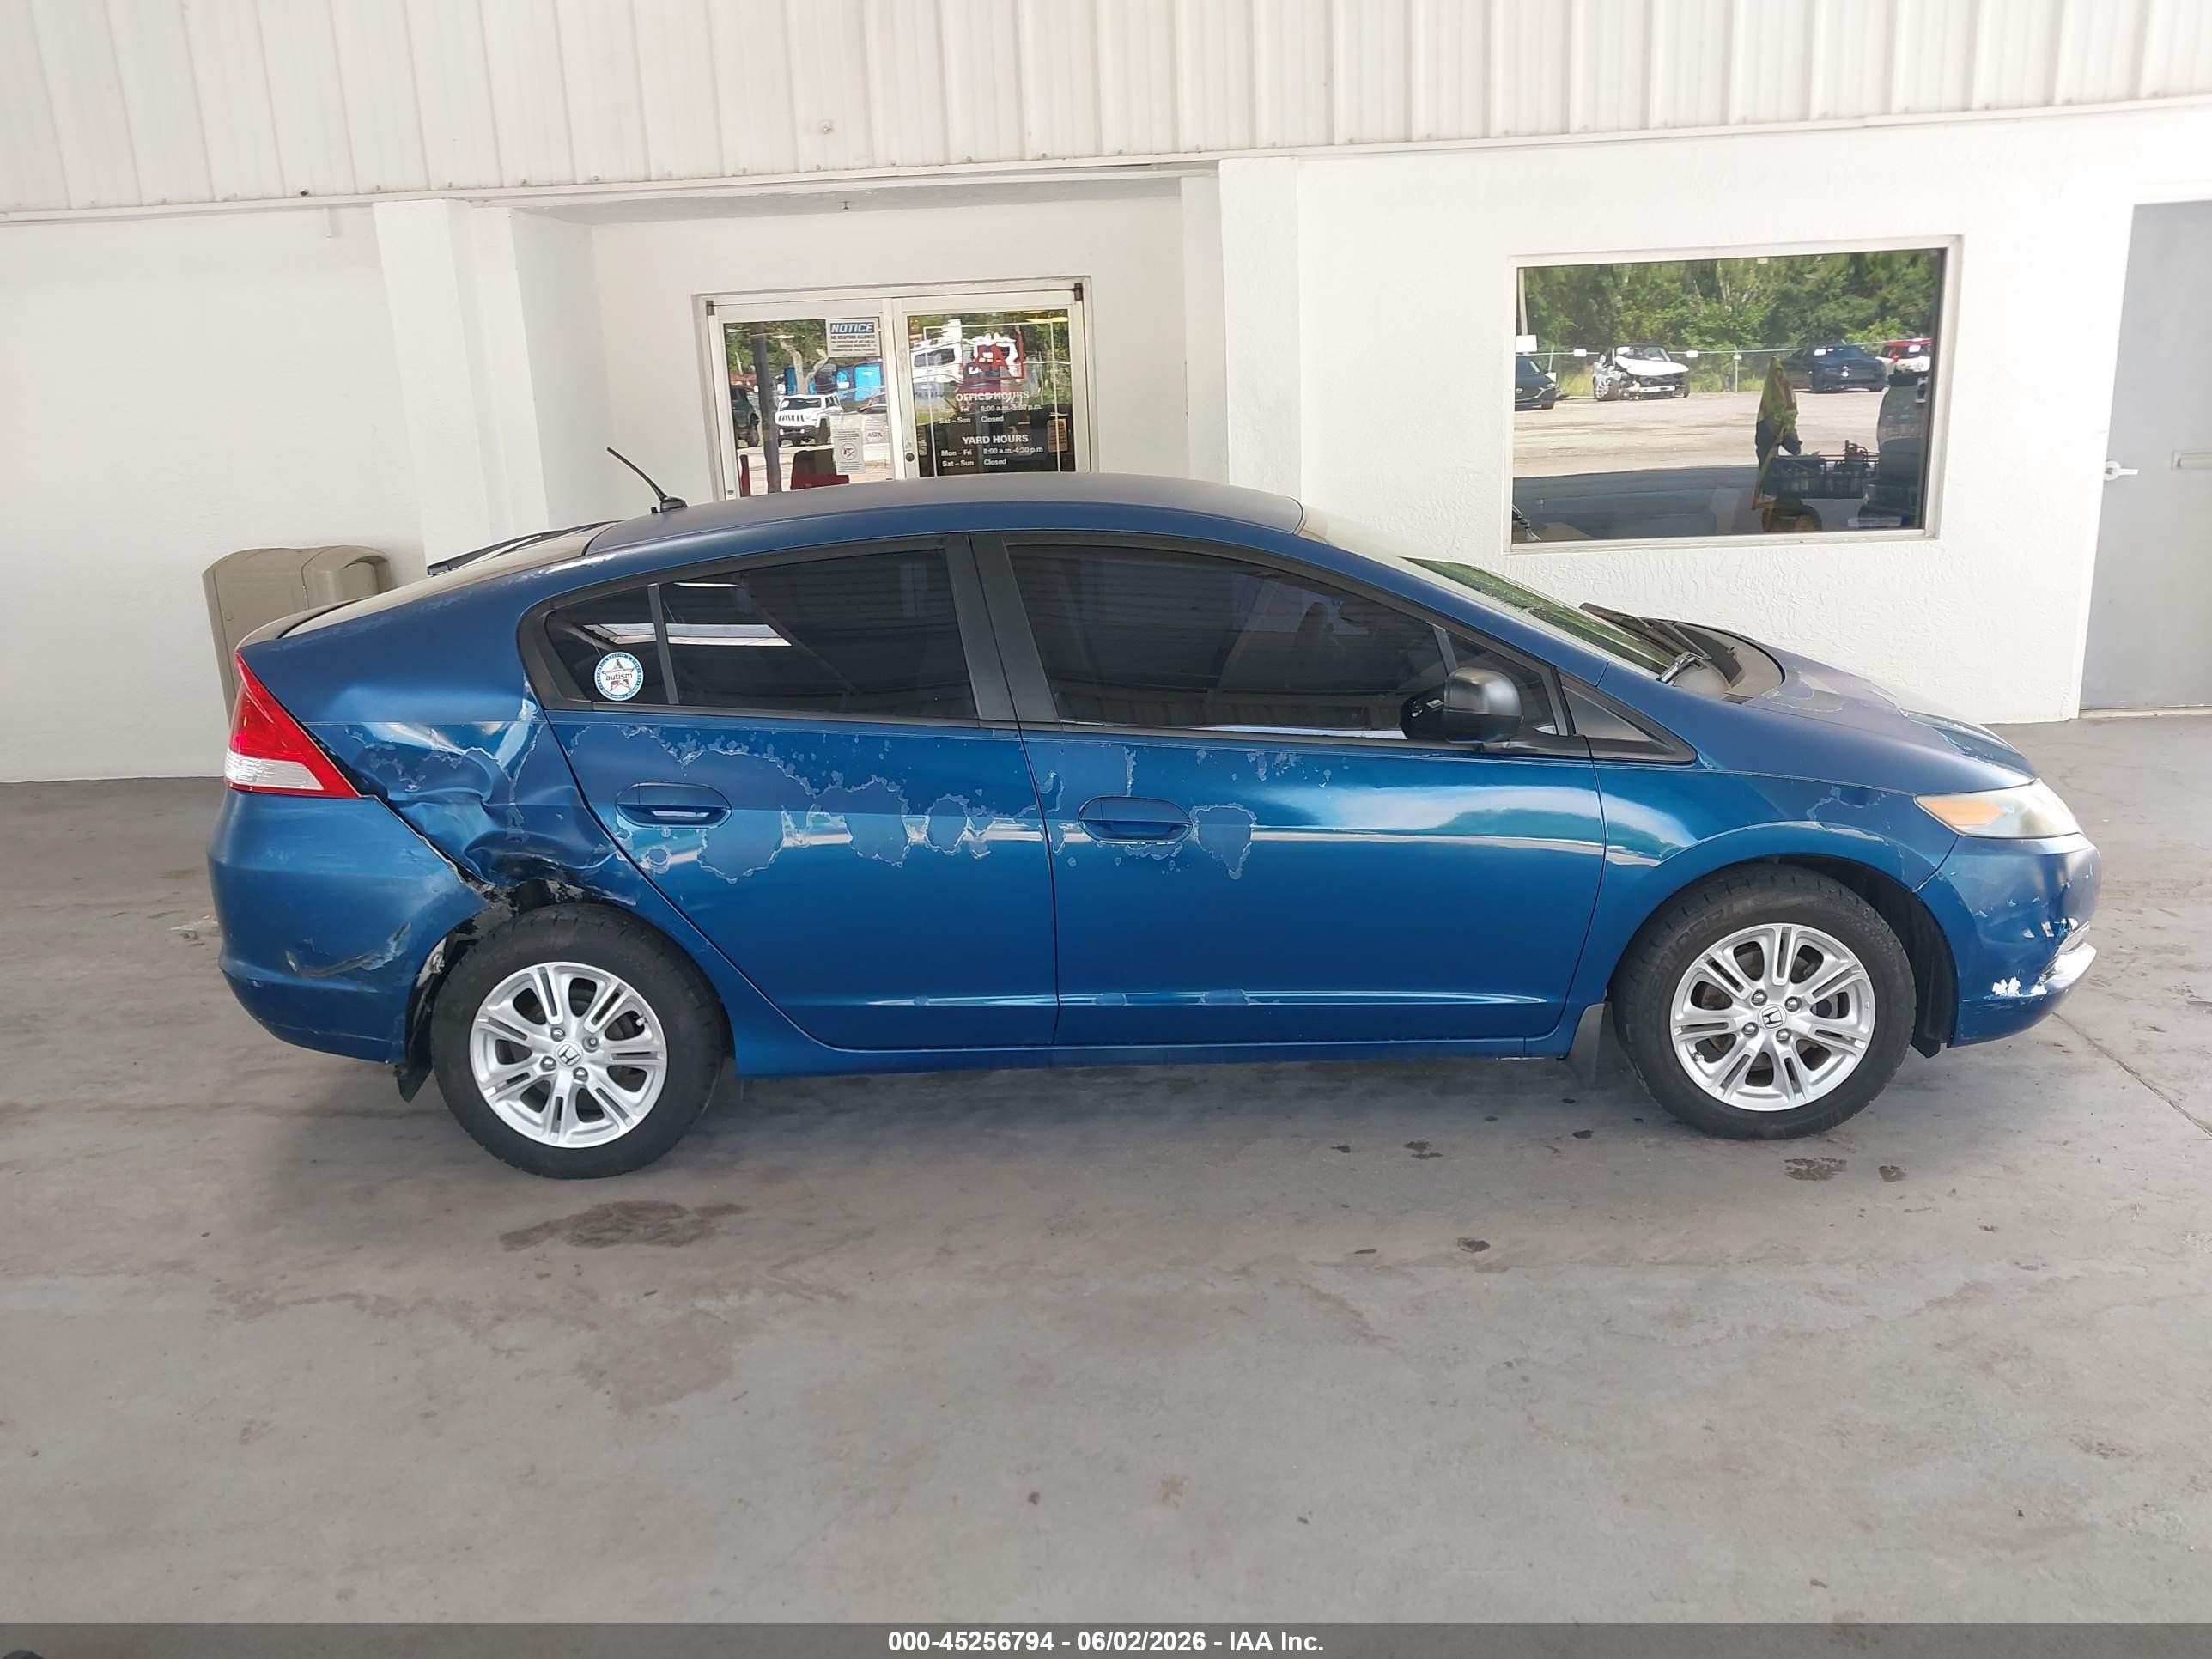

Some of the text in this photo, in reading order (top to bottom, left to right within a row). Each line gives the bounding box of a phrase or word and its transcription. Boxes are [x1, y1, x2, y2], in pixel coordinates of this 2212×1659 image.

[831, 323, 873, 333] NOTICE
[955, 391, 1030, 402] OFFICE HOURS
[962, 434, 1029, 445] YARD HOURS
[605, 672, 633, 681] autism
